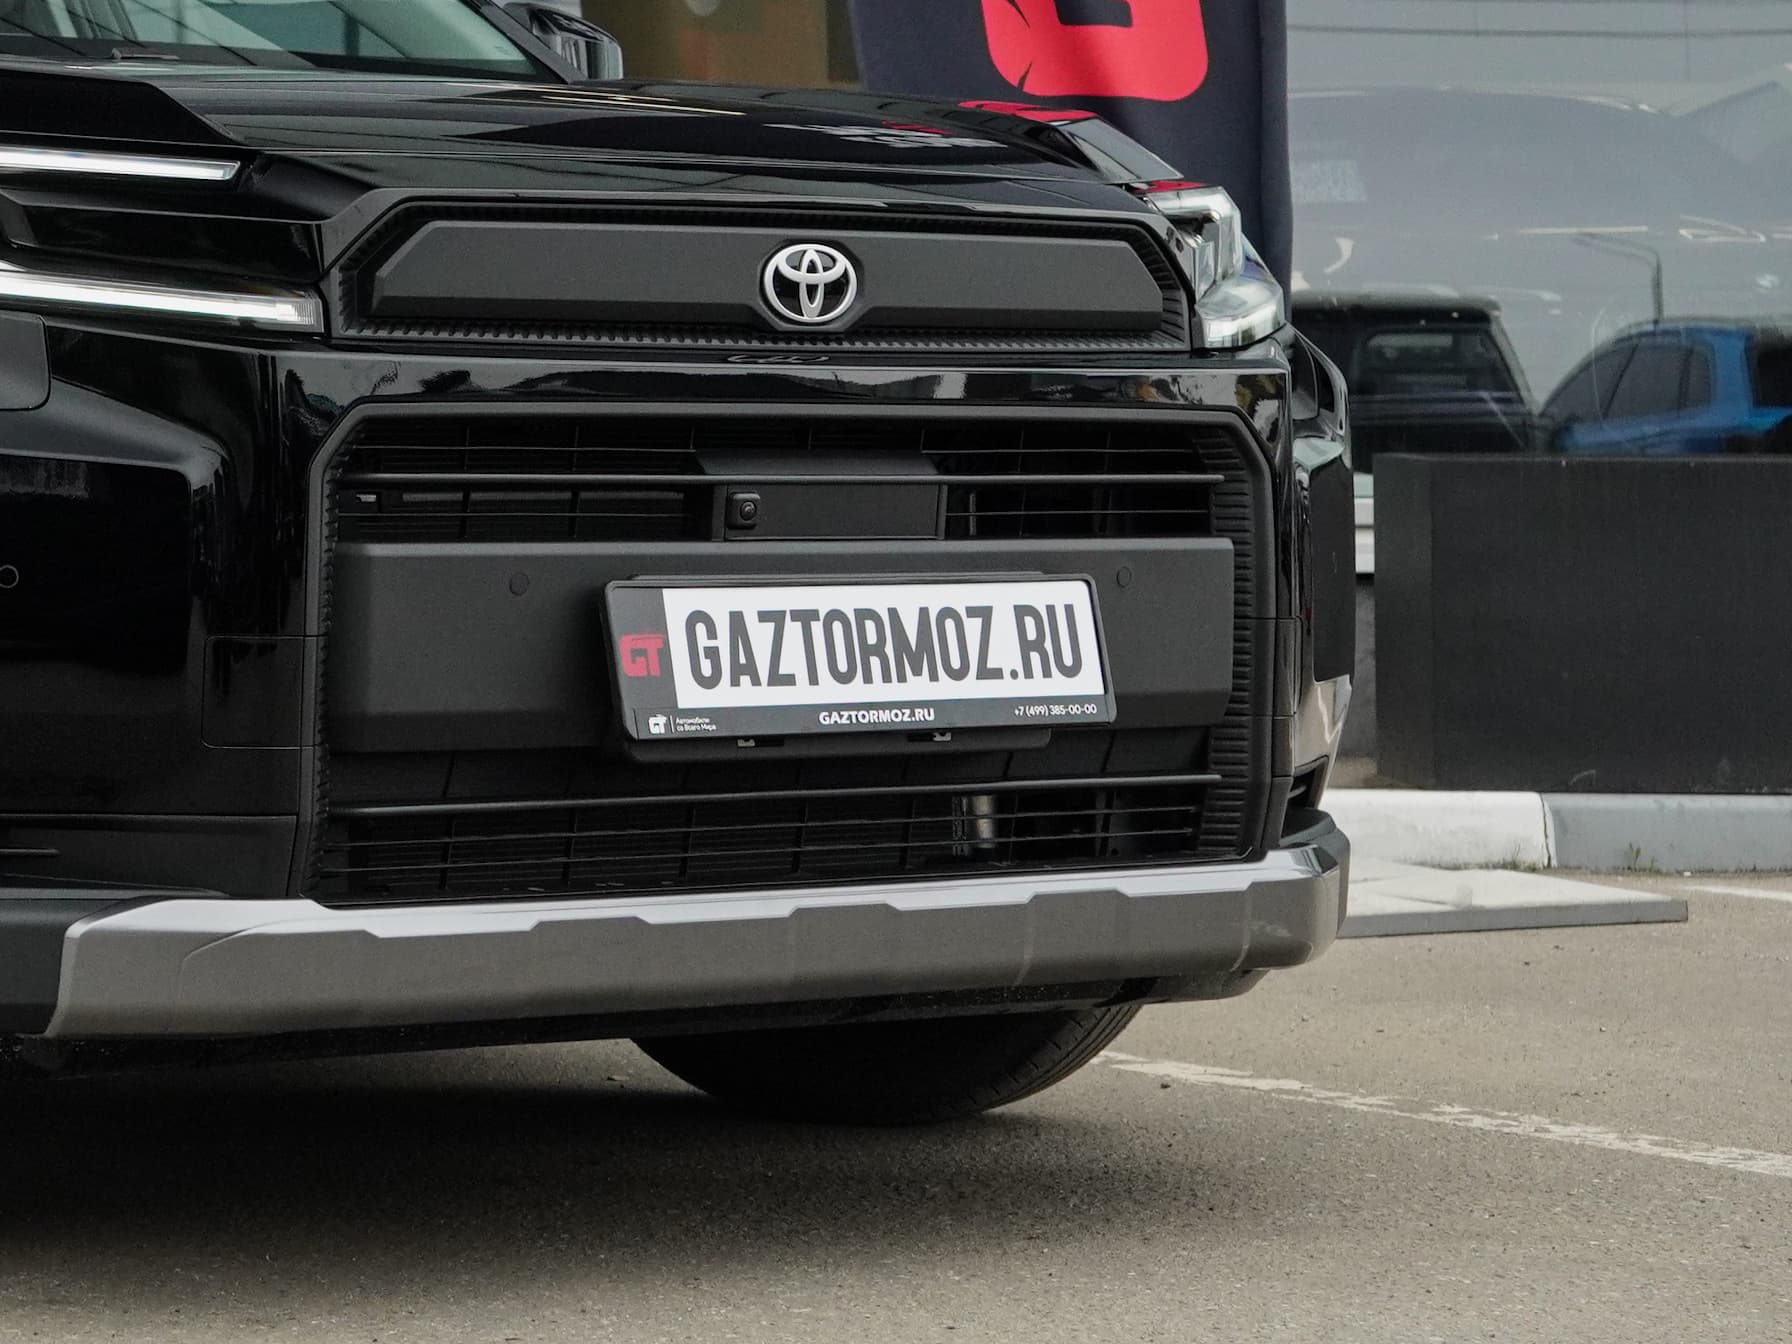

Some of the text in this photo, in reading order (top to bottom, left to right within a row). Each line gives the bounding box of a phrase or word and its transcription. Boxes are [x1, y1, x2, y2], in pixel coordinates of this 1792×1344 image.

[619, 631, 665, 678] GT
[684, 603, 1084, 690] GAZTORMOZ.RU
[818, 707, 936, 726] GAZTORMOZ.RU
[1049, 704, 1097, 716] 385-00-00
[648, 714, 667, 734] GT
